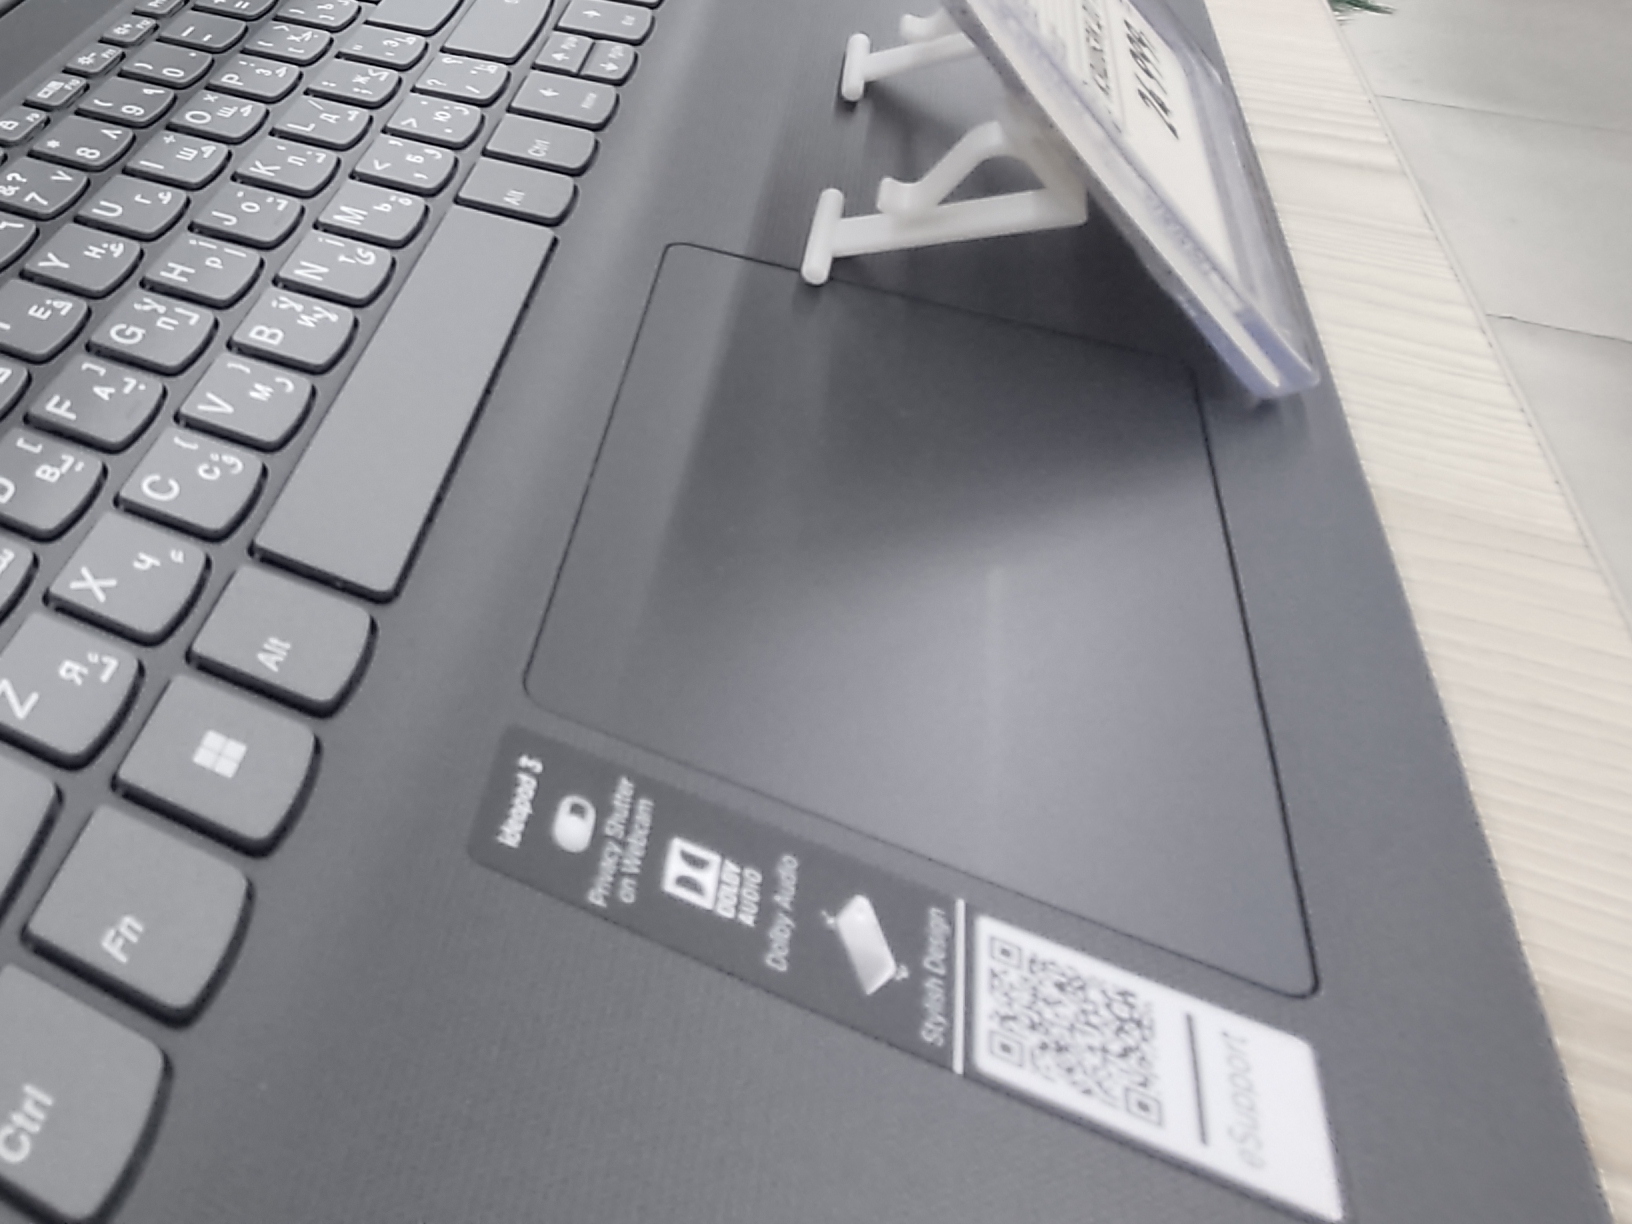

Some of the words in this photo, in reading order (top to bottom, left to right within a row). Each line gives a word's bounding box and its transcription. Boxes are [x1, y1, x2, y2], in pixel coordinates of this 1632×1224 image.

[161, 67, 185, 79] 0
[221, 73, 245, 87] P
[120, 104, 145, 117] 9
[184, 110, 212, 125] O
[286, 123, 316, 132] L
[75, 146, 101, 161] 8
[248, 159, 282, 177] K
[22, 191, 49, 207] 7
[92, 200, 123, 218] U
[211, 210, 238, 226] J
[332, 205, 368, 226] M
[37, 251, 71, 269] Y
[293, 260, 330, 282] N
[159, 261, 196, 283] H
[109, 323, 146, 345] G
[247, 325, 285, 346] B
[44, 394, 77, 421] F
[197, 392, 234, 414] V
[140, 474, 180, 502] C
[69, 566, 117, 603] X
[257, 637, 291, 672] Alt
[586, 840, 622, 908] Privacy
[604, 775, 635, 839] Shutter
[620, 797, 655, 874] Webcam
[619, 877, 638, 904] on
[773, 853, 799, 912] Audio
[101, 916, 143, 963] Fn
[765, 912, 796, 973] Dolby
[922, 906, 951, 976] Design
[920, 976, 948, 1047] Stylish
